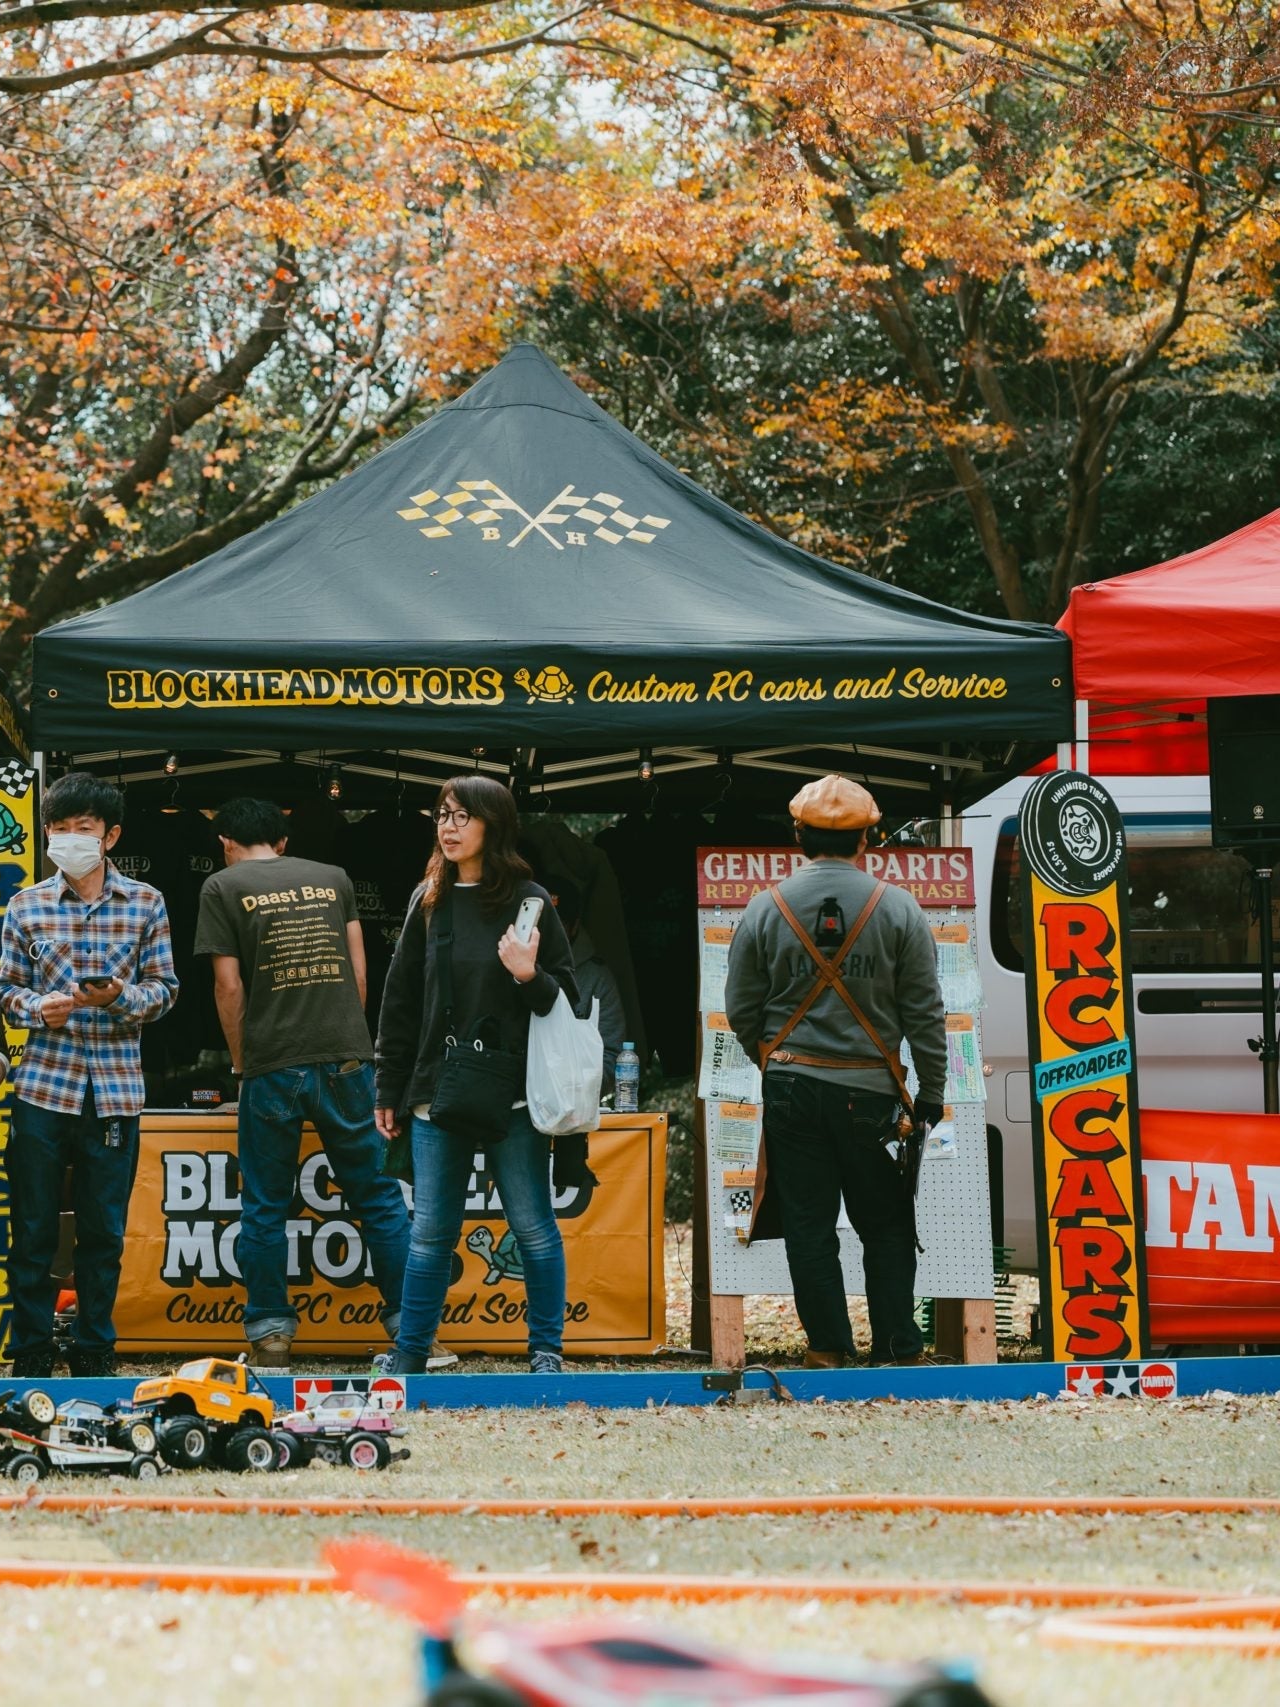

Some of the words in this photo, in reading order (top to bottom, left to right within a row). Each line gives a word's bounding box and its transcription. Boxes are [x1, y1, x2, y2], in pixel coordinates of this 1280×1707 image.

[481, 527, 501, 541] B
[565, 531, 588, 546] H
[586, 670, 699, 703] Custom
[705, 670, 753, 702] RC
[759, 677, 827, 701] cars
[833, 667, 897, 699] and
[897, 667, 1008, 699] Service
[1051, 781, 1088, 804] UNLIMITED
[1089, 785, 1108, 804] TIRES
[703, 853, 812, 881] GENER
[864, 853, 968, 881] PARTS
[241, 889, 300, 912] Daast
[301, 886, 337, 901] Bag
[1039, 902, 1119, 1052] RC
[1038, 1048, 1128, 1090] OFFROADER
[1049, 1088, 1133, 1361] CARS
[166, 1293, 247, 1324] Custo
[339, 1299, 388, 1324] car
[440, 1293, 477, 1324] nd
[479, 1292, 590, 1324] Serce
